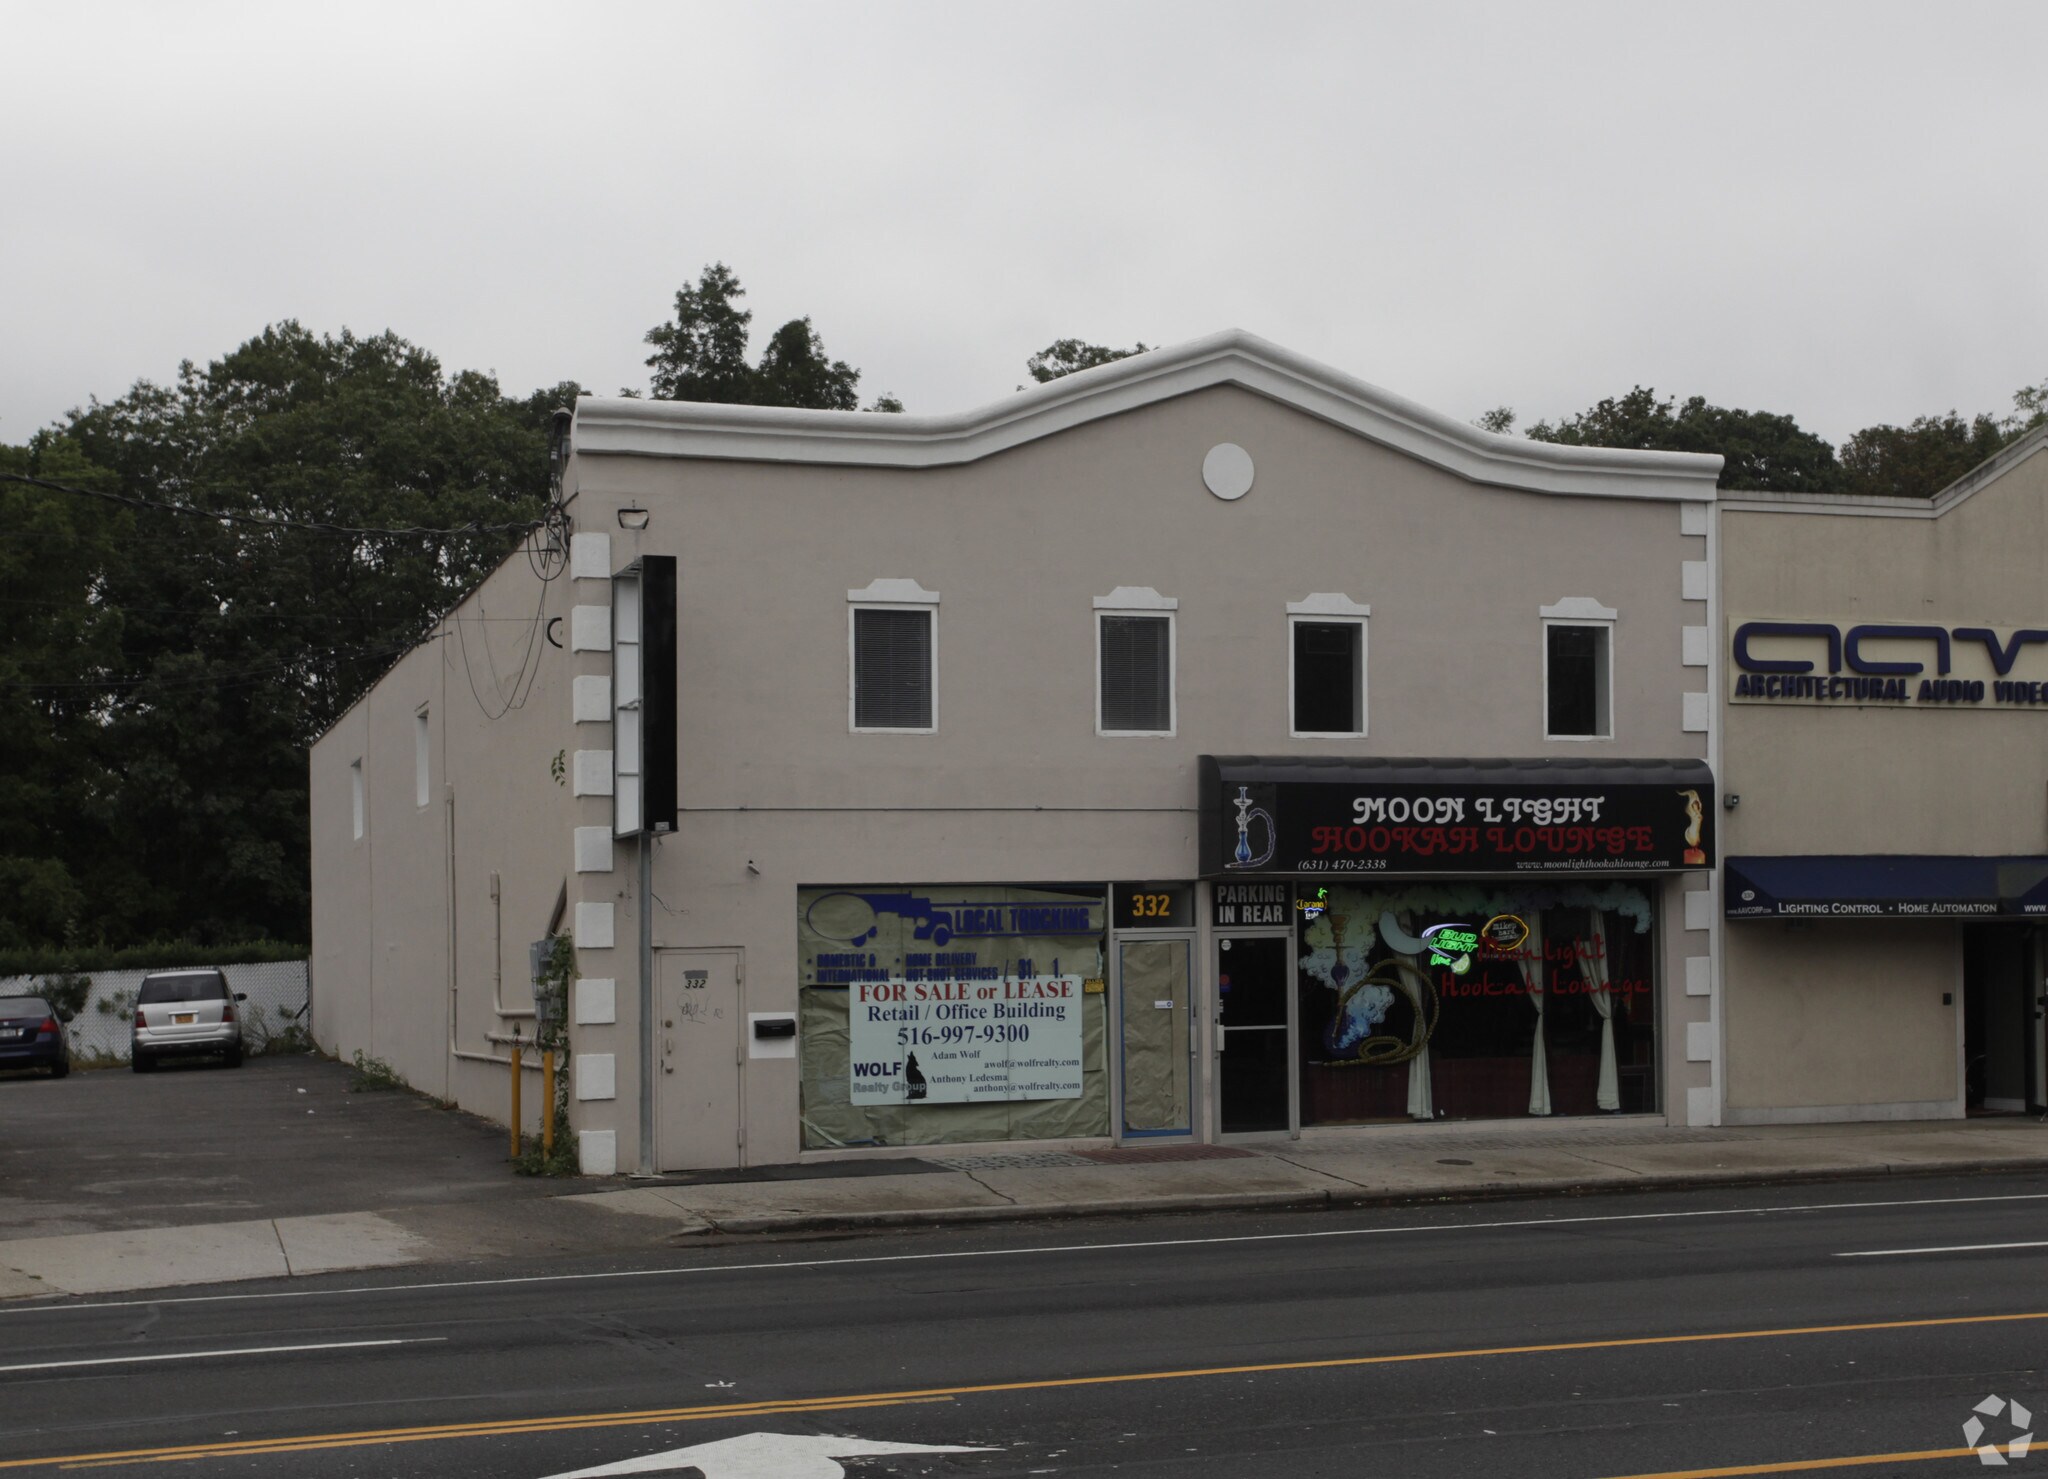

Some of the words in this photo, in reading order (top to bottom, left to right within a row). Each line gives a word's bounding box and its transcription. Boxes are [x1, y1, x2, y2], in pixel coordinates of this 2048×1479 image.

[1735, 674, 1910, 700] ARCHITECTURAL
[1917, 680, 1984, 702] AUDIO
[1352, 797, 1465, 824] MOON
[1475, 796, 1605, 825] LIGHT
[1311, 826, 1479, 856] HOOKAH
[1486, 826, 1654, 854] LOUNGE
[1298, 859, 1329, 871] (631)
[1332, 859, 1387, 870] 470-2338
[1516, 858, 1670, 870] www.moonlighthookahlounge.com
[1217, 885, 1285, 903] PARKING
[1132, 894, 1171, 917] 332
[955, 909, 1004, 932] LOCAL
[1010, 908, 1090, 931] TRUCKING
[1219, 906, 1235, 923] IN
[1243, 905, 1283, 923] REAR
[1439, 928, 1477, 943] BUD
[1429, 938, 1479, 952] LIGHT
[936, 952, 977, 966] DELIVERY
[817, 969, 890, 982] INTERNATIONAL
[955, 967, 998, 980] SERVICES
[685, 980, 706, 989] 332
[1441, 970, 1544, 997] Hookah
[1552, 969, 1650, 998] Lounge
[859, 984, 908, 1002] FOR
[914, 983, 970, 1001] SALE
[977, 986, 997, 1000] or
[1005, 981, 1073, 999] LEASE
[868, 1003, 919, 1022] Retail
[925, 1004, 931, 1020] /
[936, 1003, 987, 1020] Office
[993, 1002, 1065, 1021] Building
[897, 1024, 1029, 1046] 516-997-9300
[931, 1051, 957, 1060] Adam
[959, 1050, 981, 1059] Wolf
[853, 1062, 902, 1077] WOLF
[929, 1074, 966, 1084] Anthony
[969, 1073, 1008, 1083] Ledesma
[853, 1082, 889, 1095] Realty
[892, 1082, 927, 1095] Group
